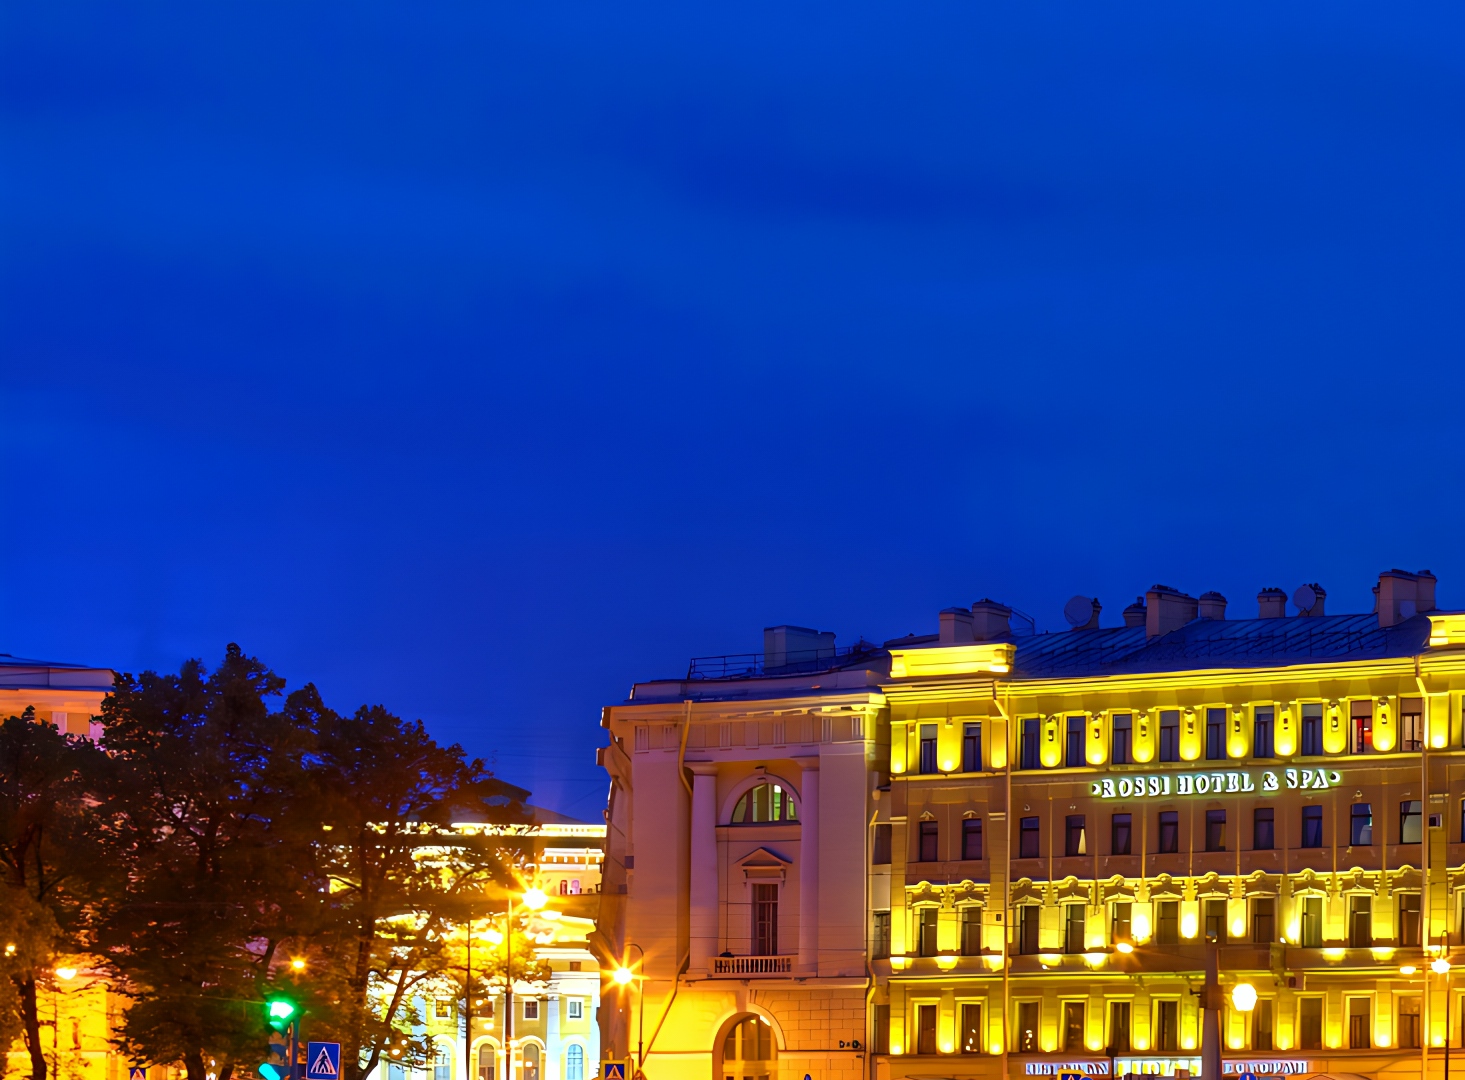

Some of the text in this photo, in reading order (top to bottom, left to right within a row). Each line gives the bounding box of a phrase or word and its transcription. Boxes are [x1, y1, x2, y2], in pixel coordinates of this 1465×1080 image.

[1101, 768, 1329, 798] ROSSI HOTEL & SPA
